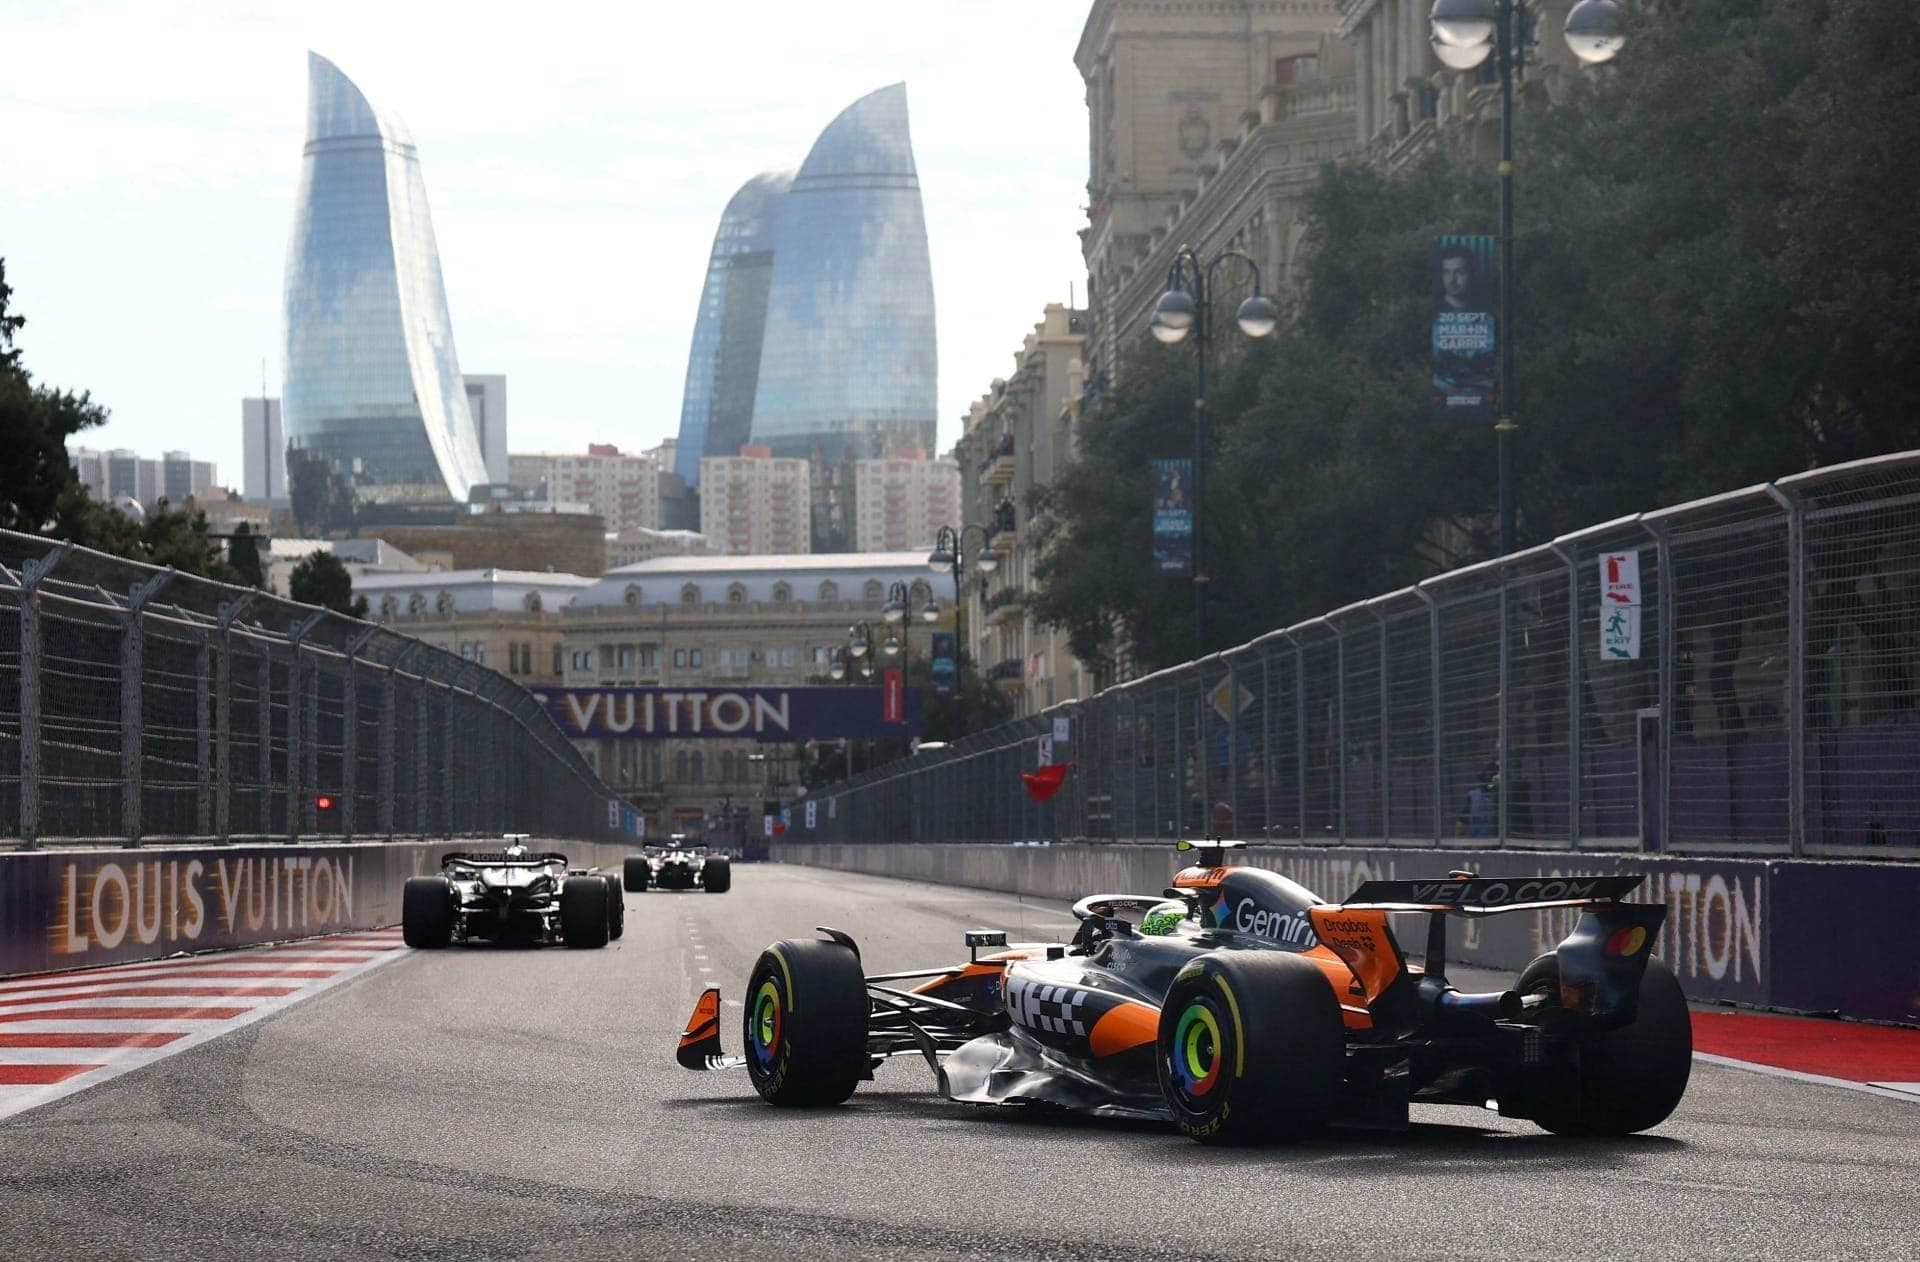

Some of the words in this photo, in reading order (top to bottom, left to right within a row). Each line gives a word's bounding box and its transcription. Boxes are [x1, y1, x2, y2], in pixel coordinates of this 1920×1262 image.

[1439, 312, 1455, 322] 20
[1457, 312, 1487, 322] SEPT
[1439, 339, 1488, 350] GARRIX
[1606, 636, 1631, 645] EXIT
[567, 692, 790, 733] VUITTON
[1411, 880, 1598, 904] VELO.COM
[66, 859, 205, 953] LOUIS
[218, 855, 354, 935] VUITTON
[1323, 918, 1372, 935] Dropbox
[1180, 1116, 1221, 1136] ZERO
